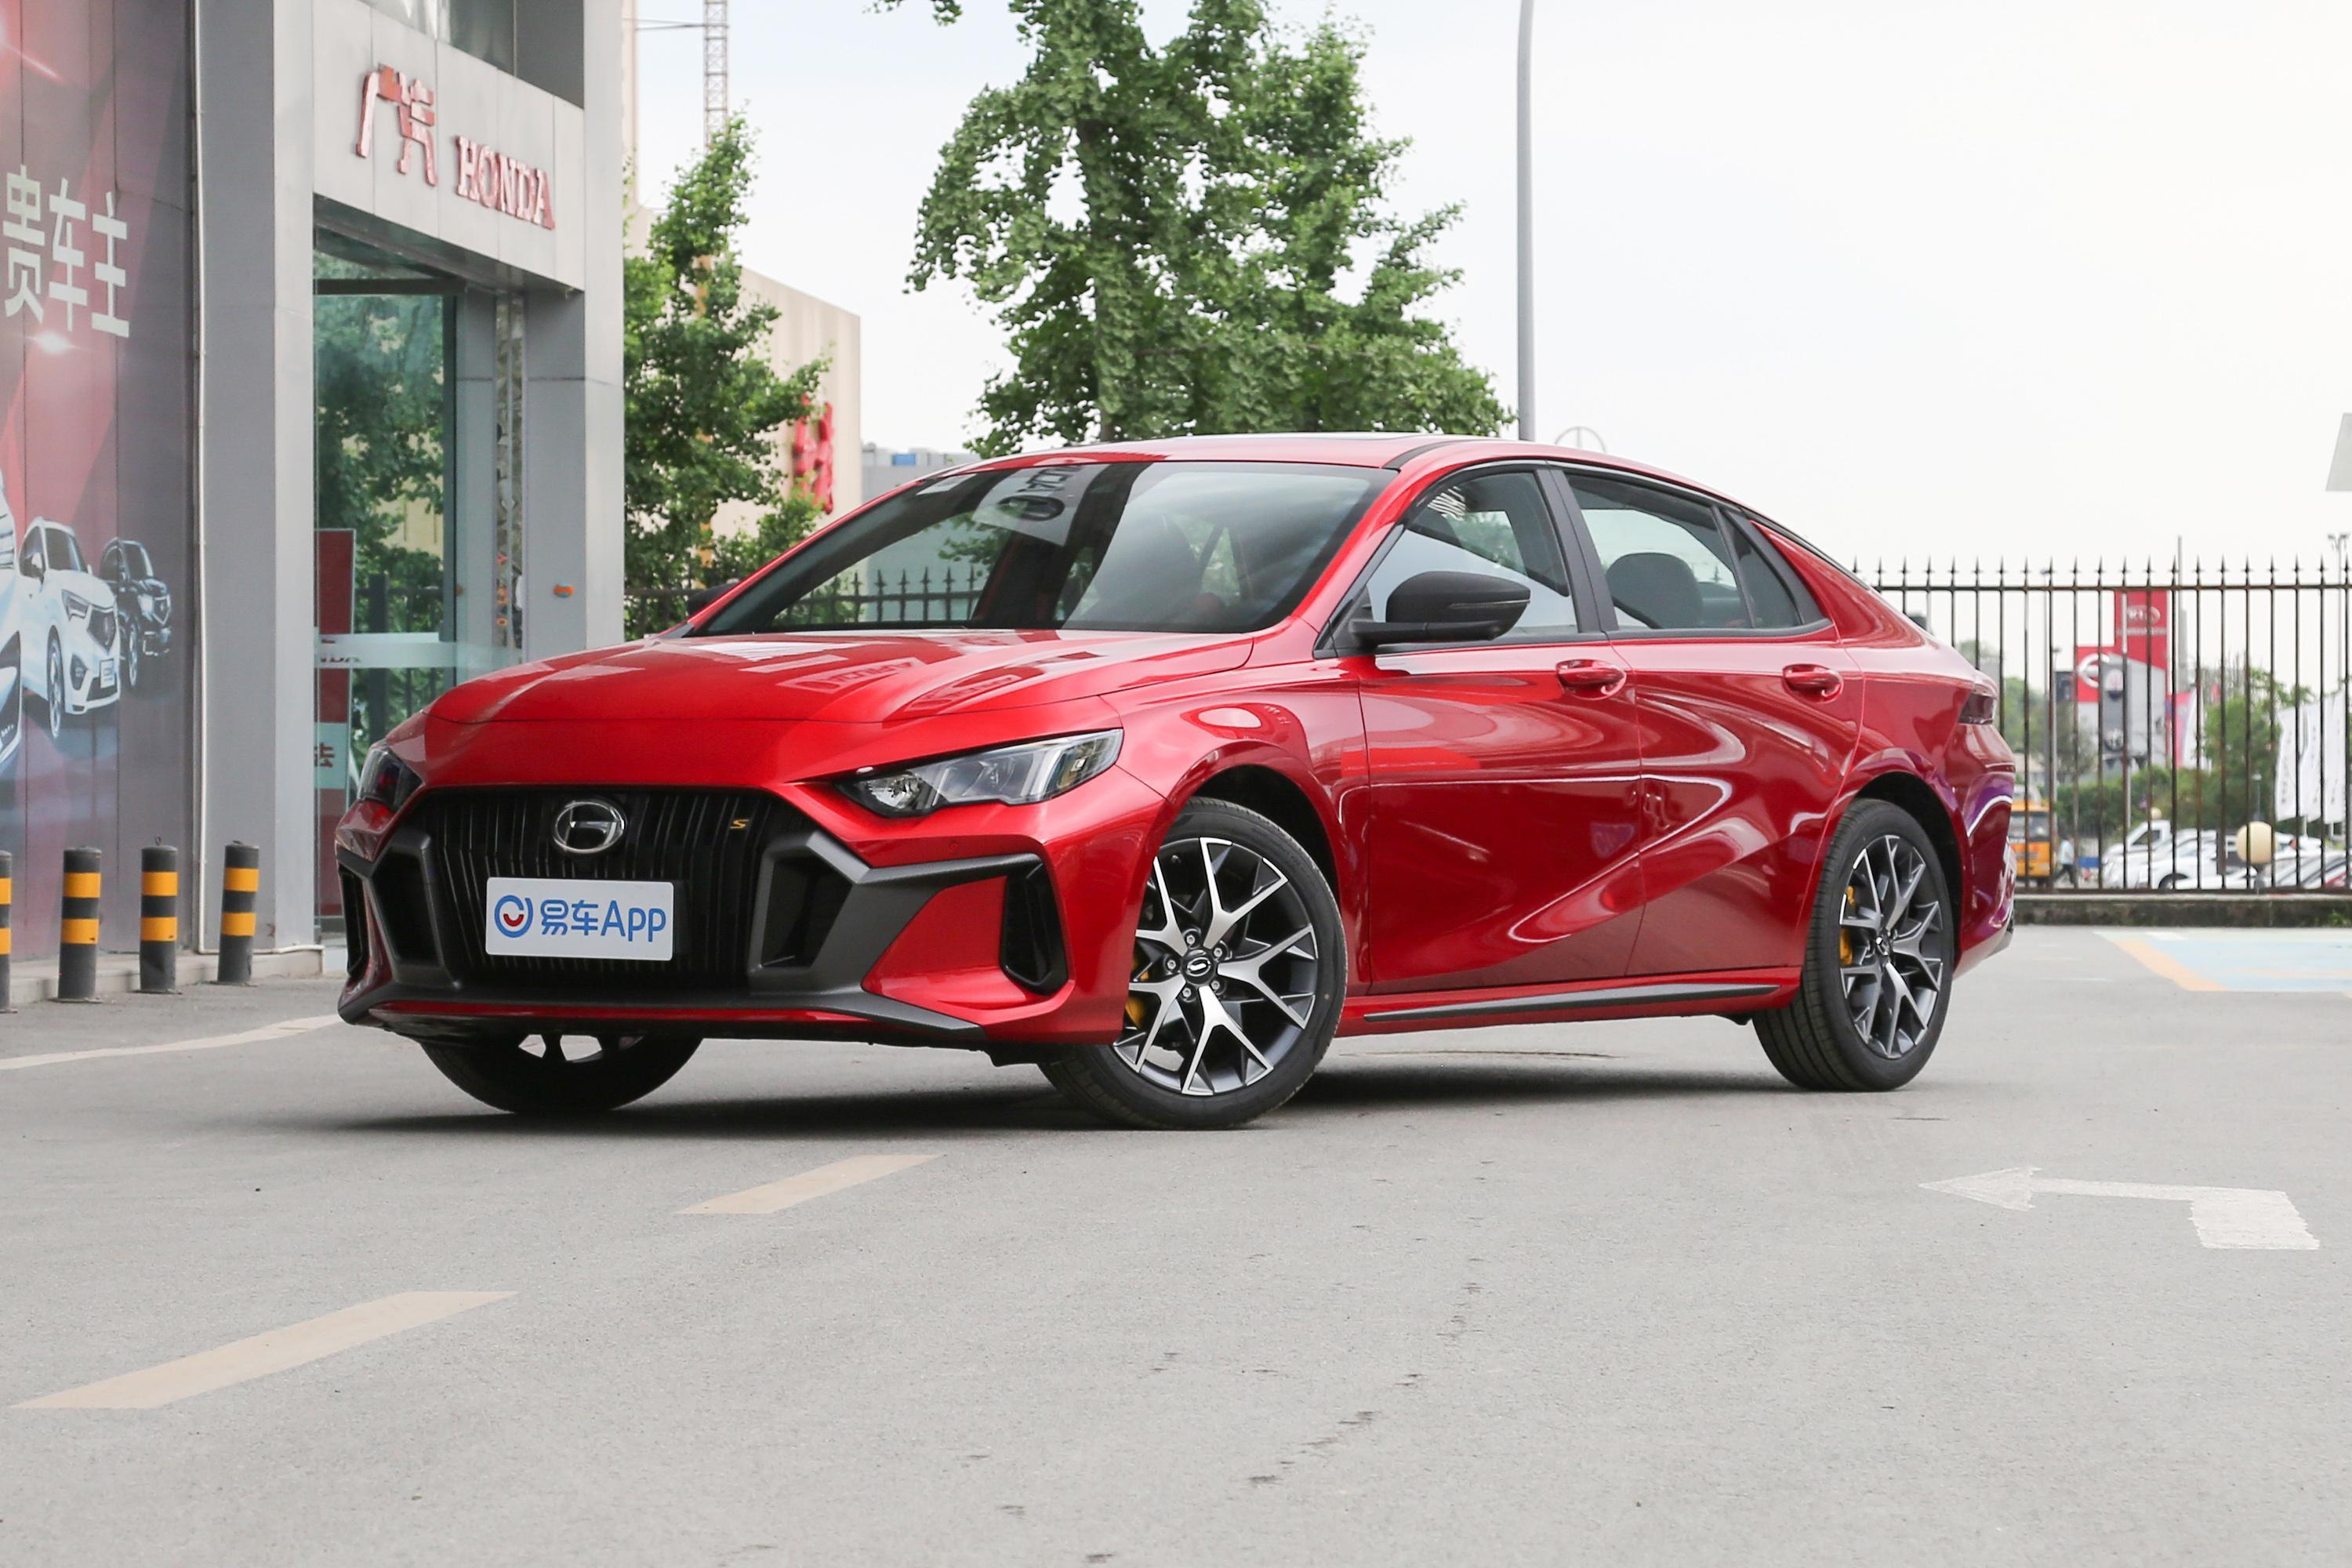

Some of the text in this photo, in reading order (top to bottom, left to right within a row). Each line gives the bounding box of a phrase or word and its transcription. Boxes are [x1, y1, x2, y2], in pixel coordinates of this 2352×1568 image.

[455, 135, 556, 230] HONDA
[3, 164, 129, 338] 贵车主
[539, 898, 667, 942] 易车App
